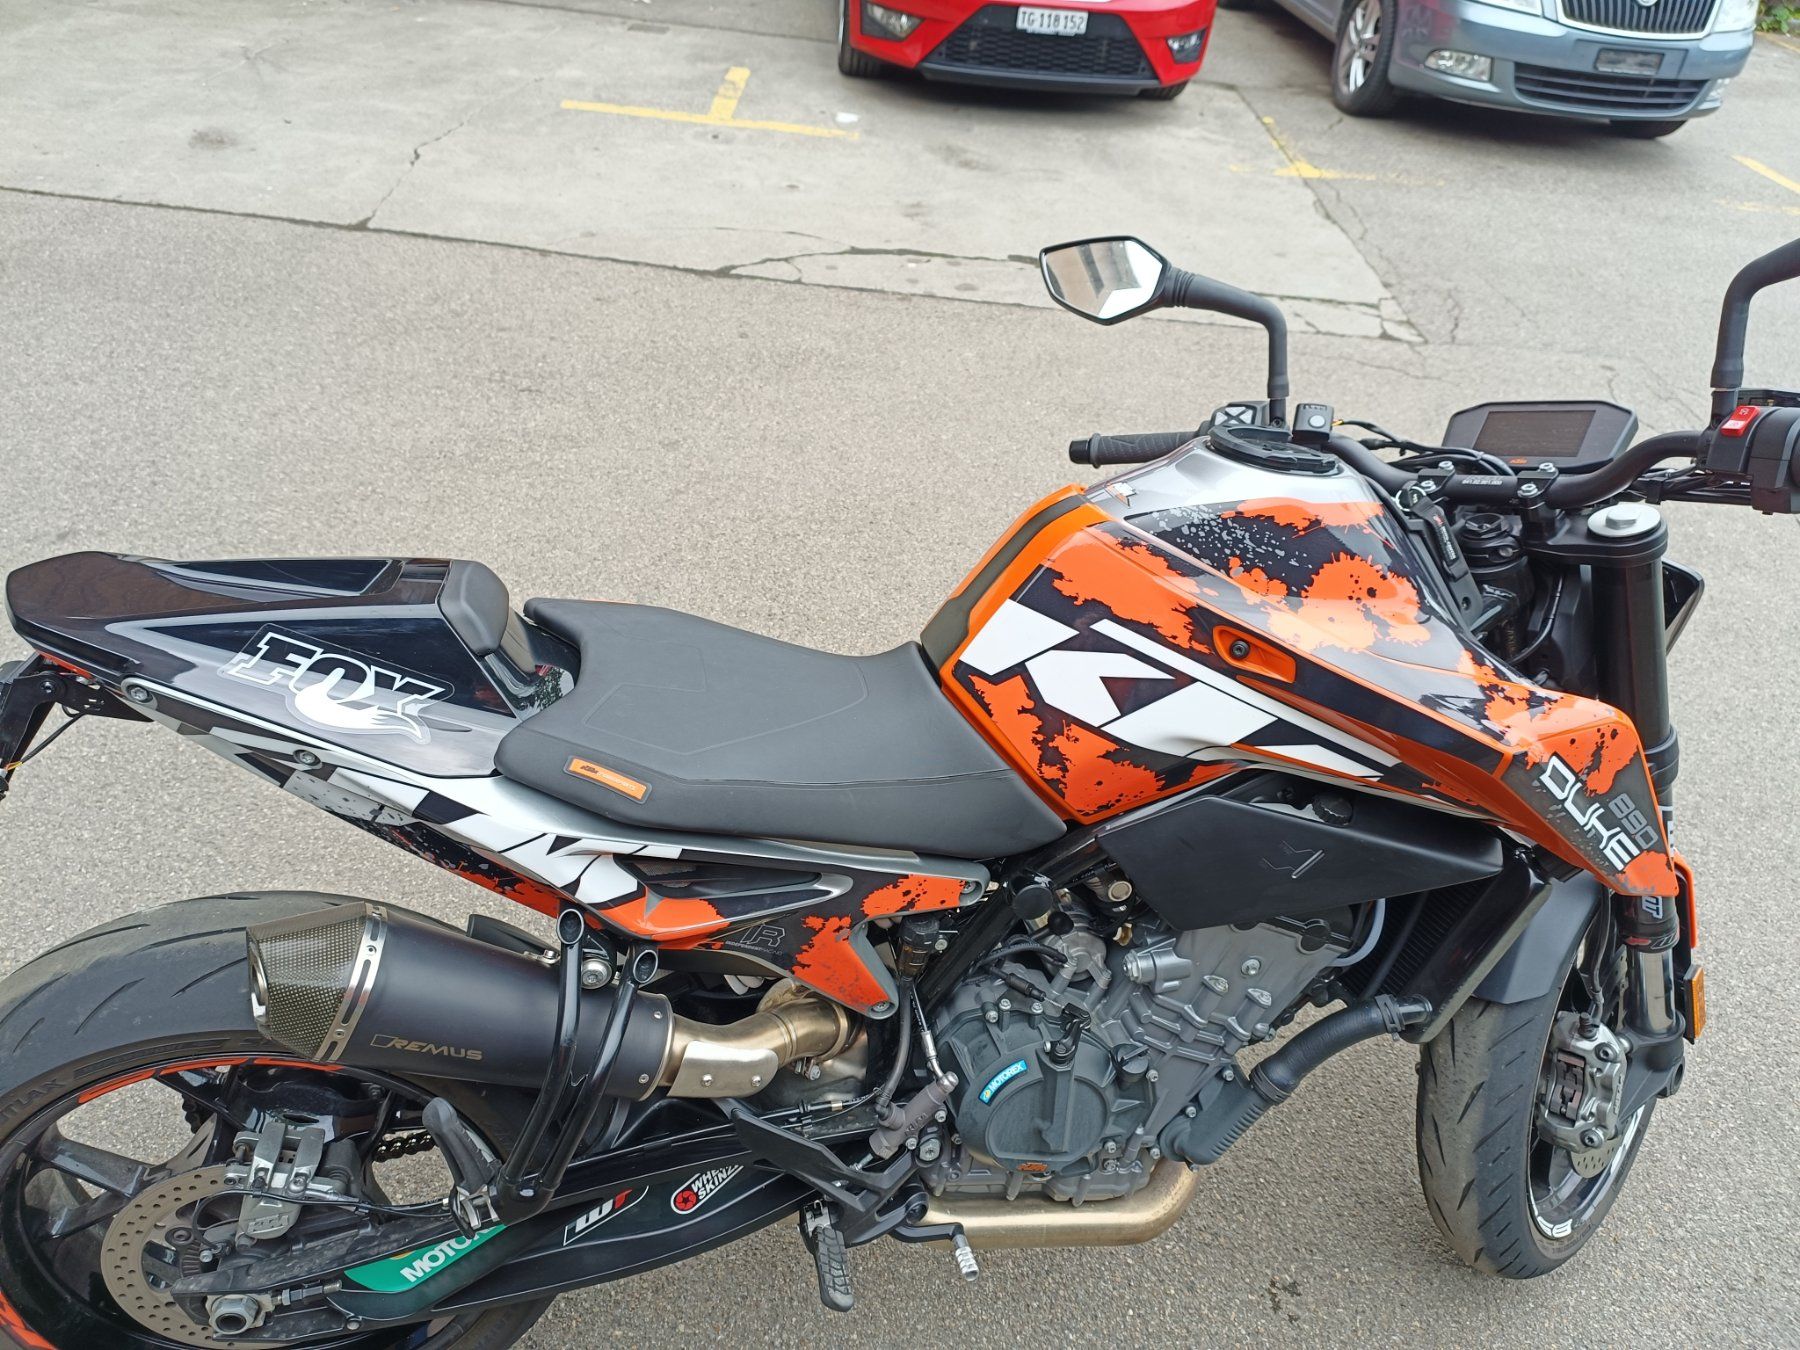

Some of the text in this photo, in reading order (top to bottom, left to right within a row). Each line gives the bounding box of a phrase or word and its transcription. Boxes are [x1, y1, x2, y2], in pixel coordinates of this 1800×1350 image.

[1020, 11, 1035, 27] TG
[1063, 15, 1085, 31] 152
[227, 631, 448, 739] FOX
[1539, 755, 1640, 872] DUKE
[1608, 793, 1658, 850] 890
[387, 1036, 483, 1061] REMUS
[988, 1062, 1023, 1094] MOTOREX
[697, 1164, 739, 1200] SKINZ
